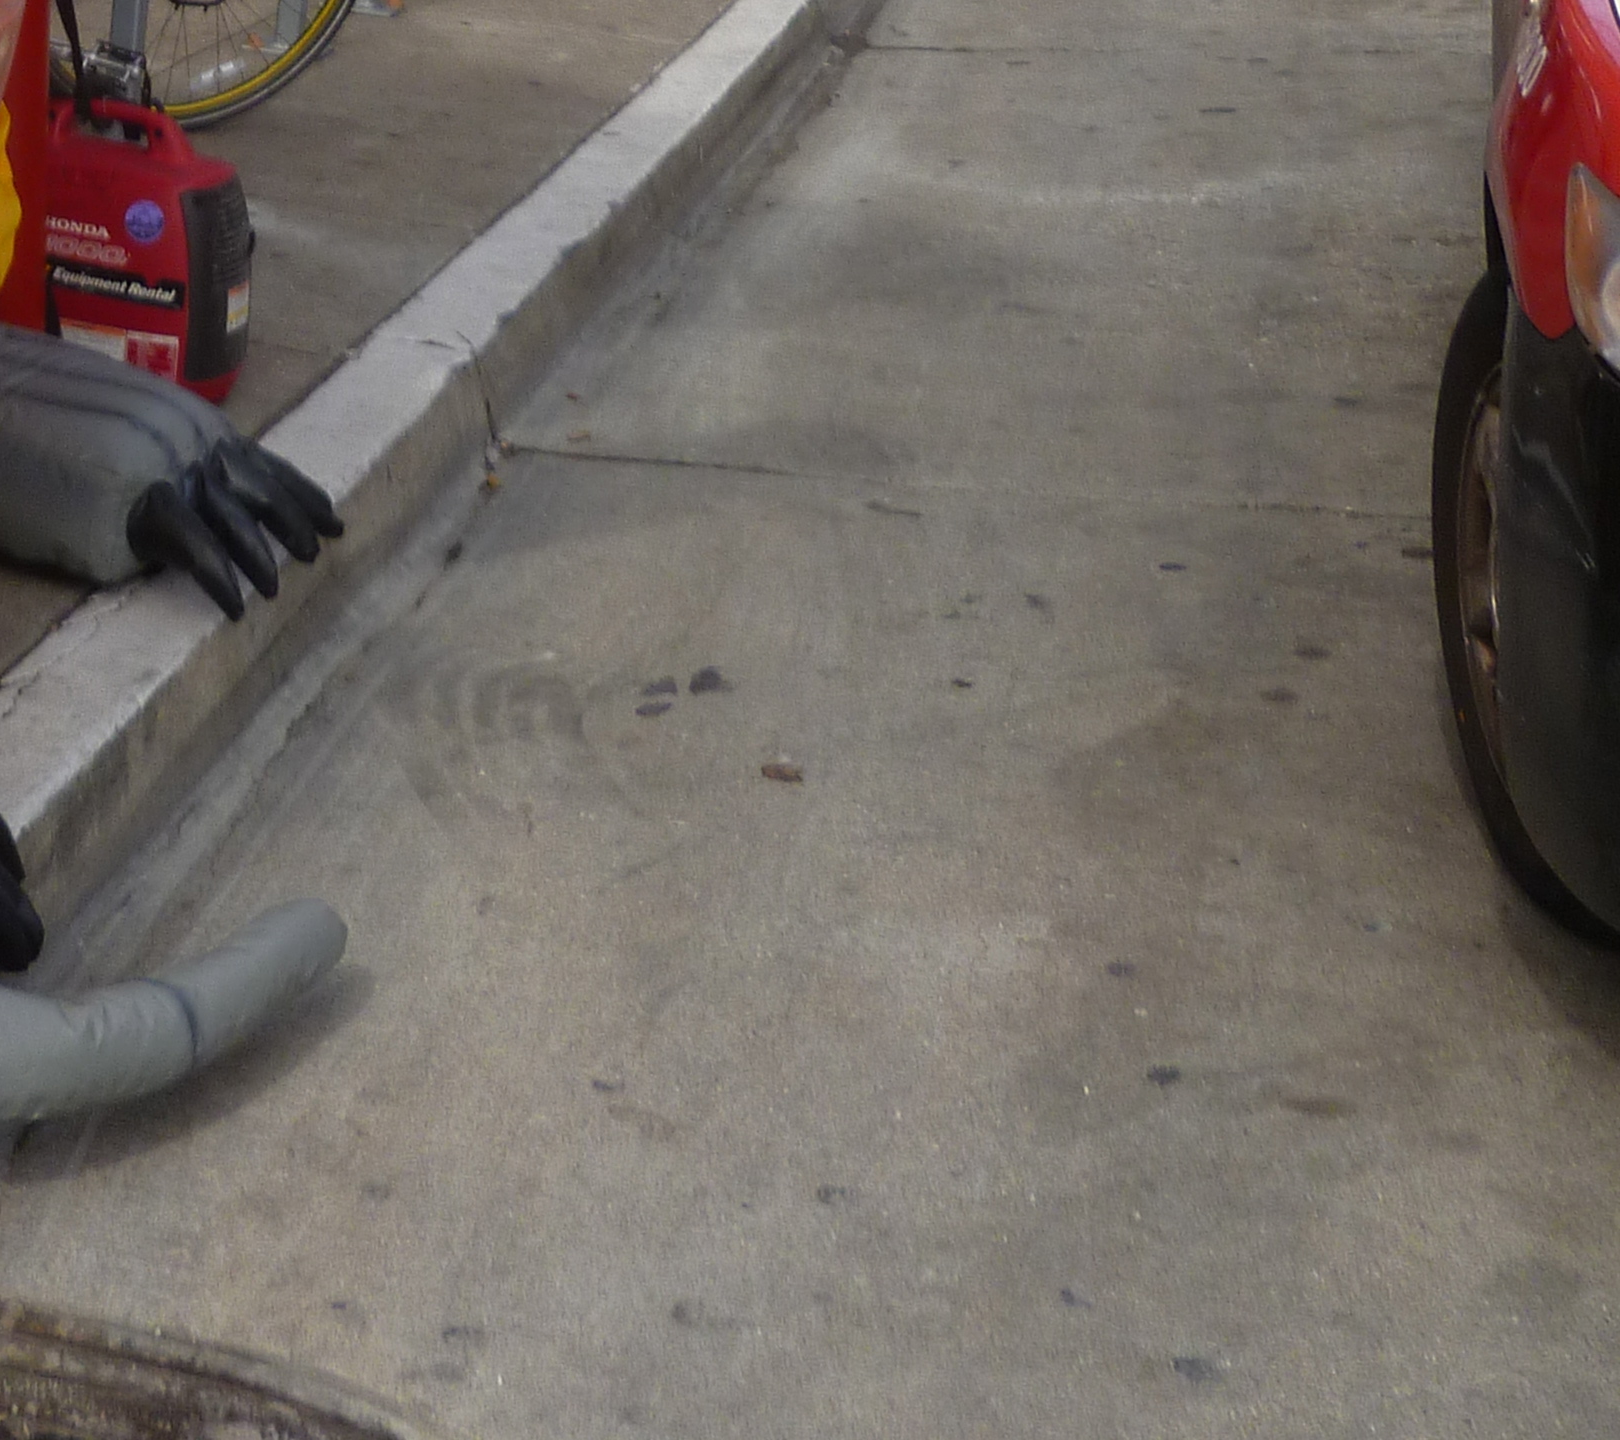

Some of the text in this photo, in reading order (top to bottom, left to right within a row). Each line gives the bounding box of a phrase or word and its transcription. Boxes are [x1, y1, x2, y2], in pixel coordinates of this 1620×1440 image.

[46, 214, 111, 241] HONDA
[52, 265, 177, 303] Equipment Rental
